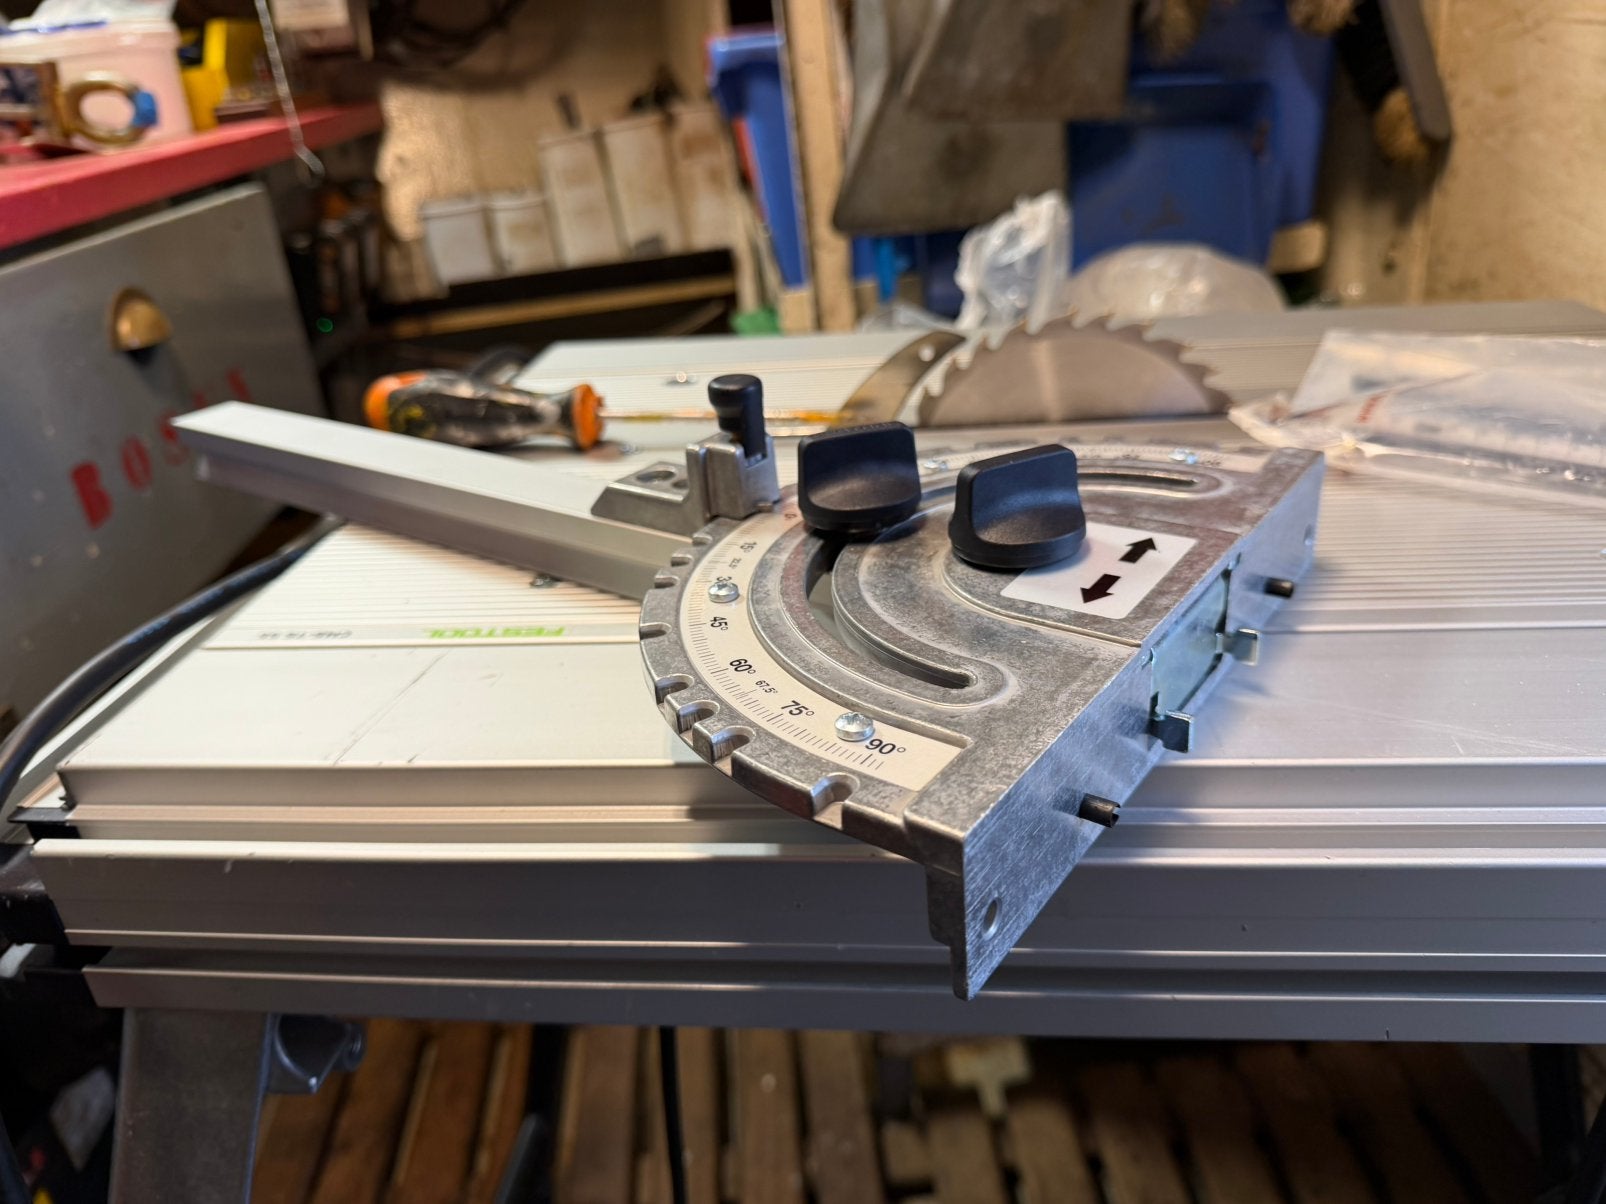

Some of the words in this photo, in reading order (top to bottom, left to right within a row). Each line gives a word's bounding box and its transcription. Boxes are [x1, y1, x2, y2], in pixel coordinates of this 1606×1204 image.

[710, 616, 728, 631] 45°
[729, 658, 756, 675] 60°
[755, 679, 778, 695] 67.5°
[780, 700, 815, 717] 75°
[865, 738, 906, 755] 90°
